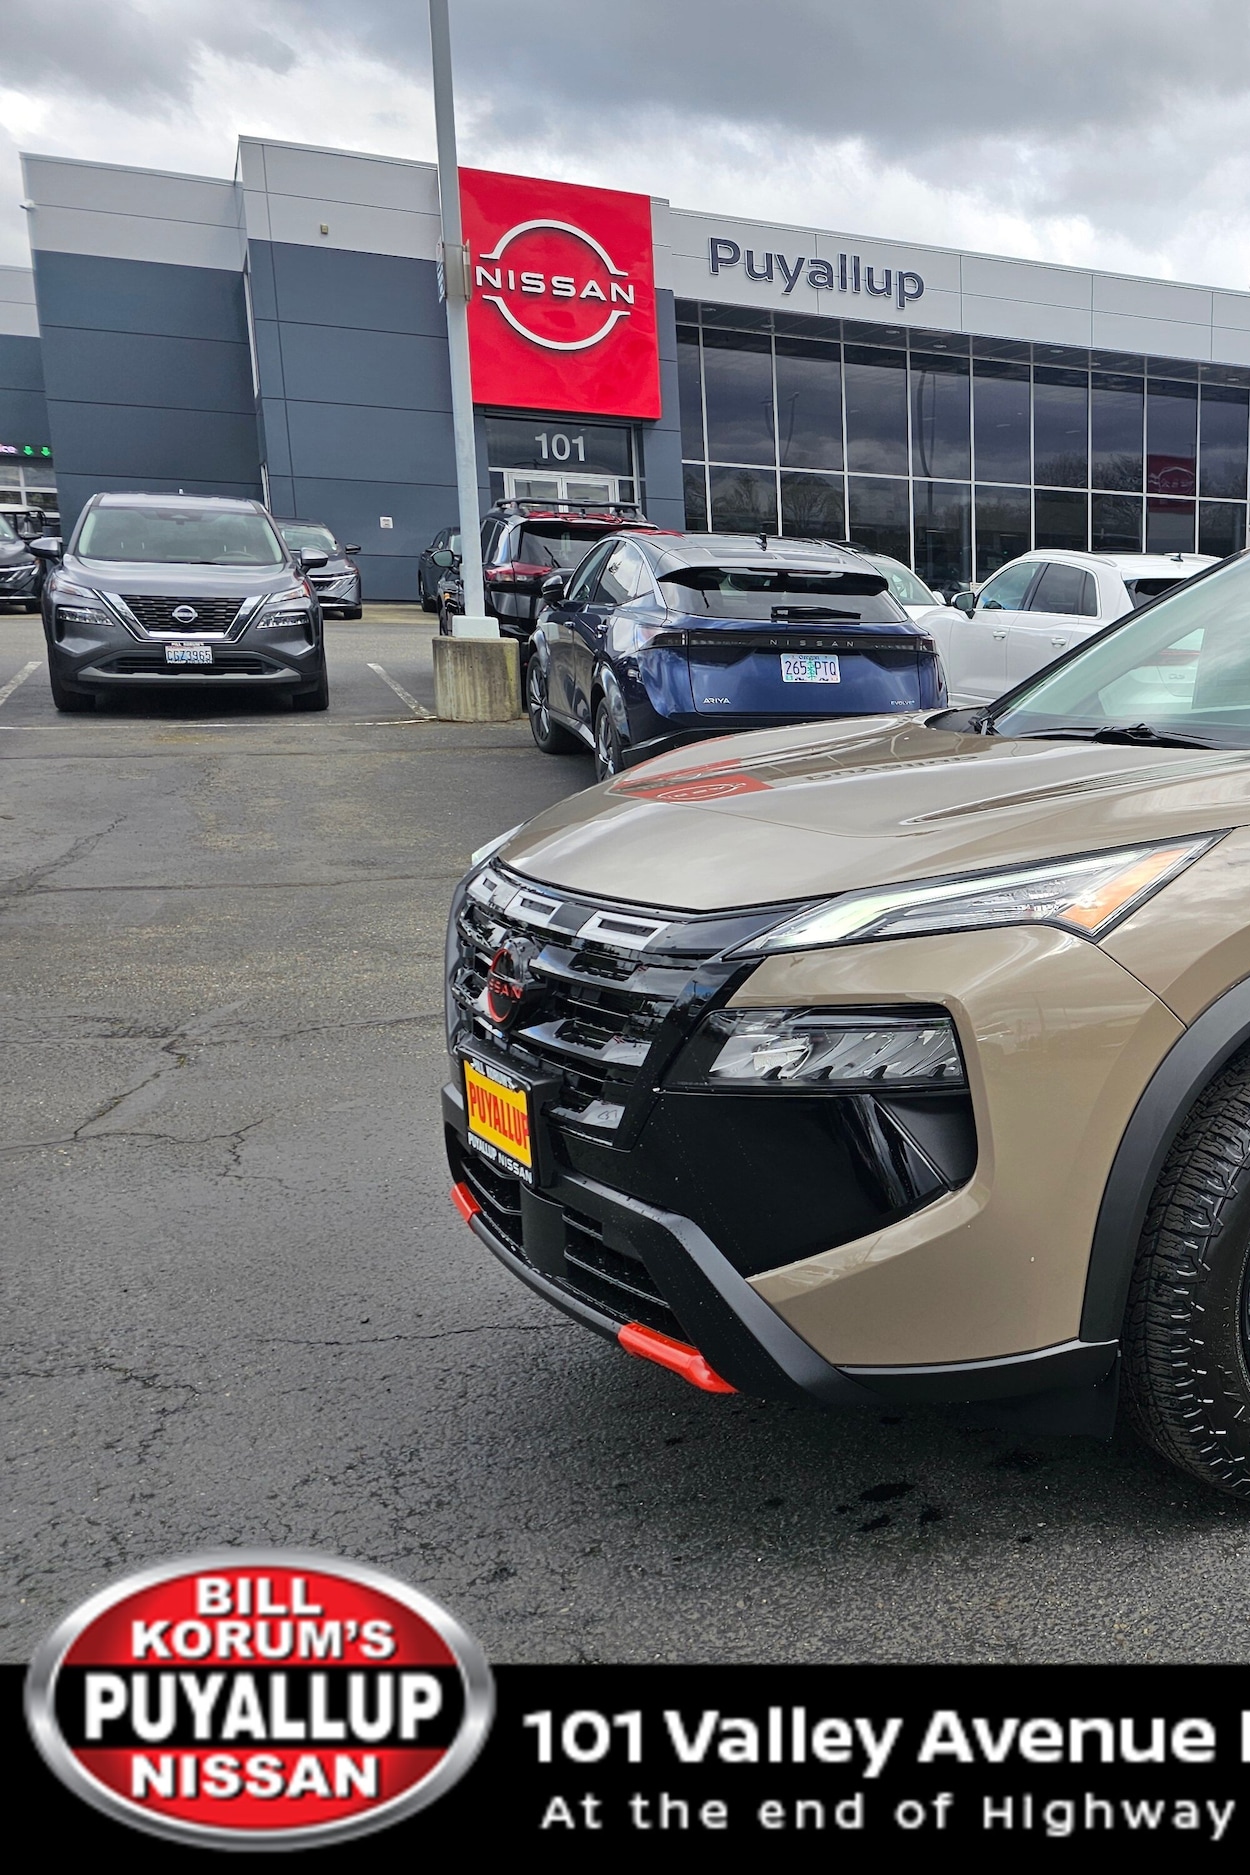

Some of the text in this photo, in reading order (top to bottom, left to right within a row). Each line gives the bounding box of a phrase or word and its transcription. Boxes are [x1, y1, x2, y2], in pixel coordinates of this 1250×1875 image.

[475, 265, 635, 305] NISSAN
[708, 236, 926, 309] Puyallup
[533, 432, 587, 462] 101
[769, 639, 855, 648] NISSAN
[784, 660, 807, 675] 265
[469, 1080, 530, 1150] PUYALLUP
[497, 1151, 534, 1185] NISSAN
